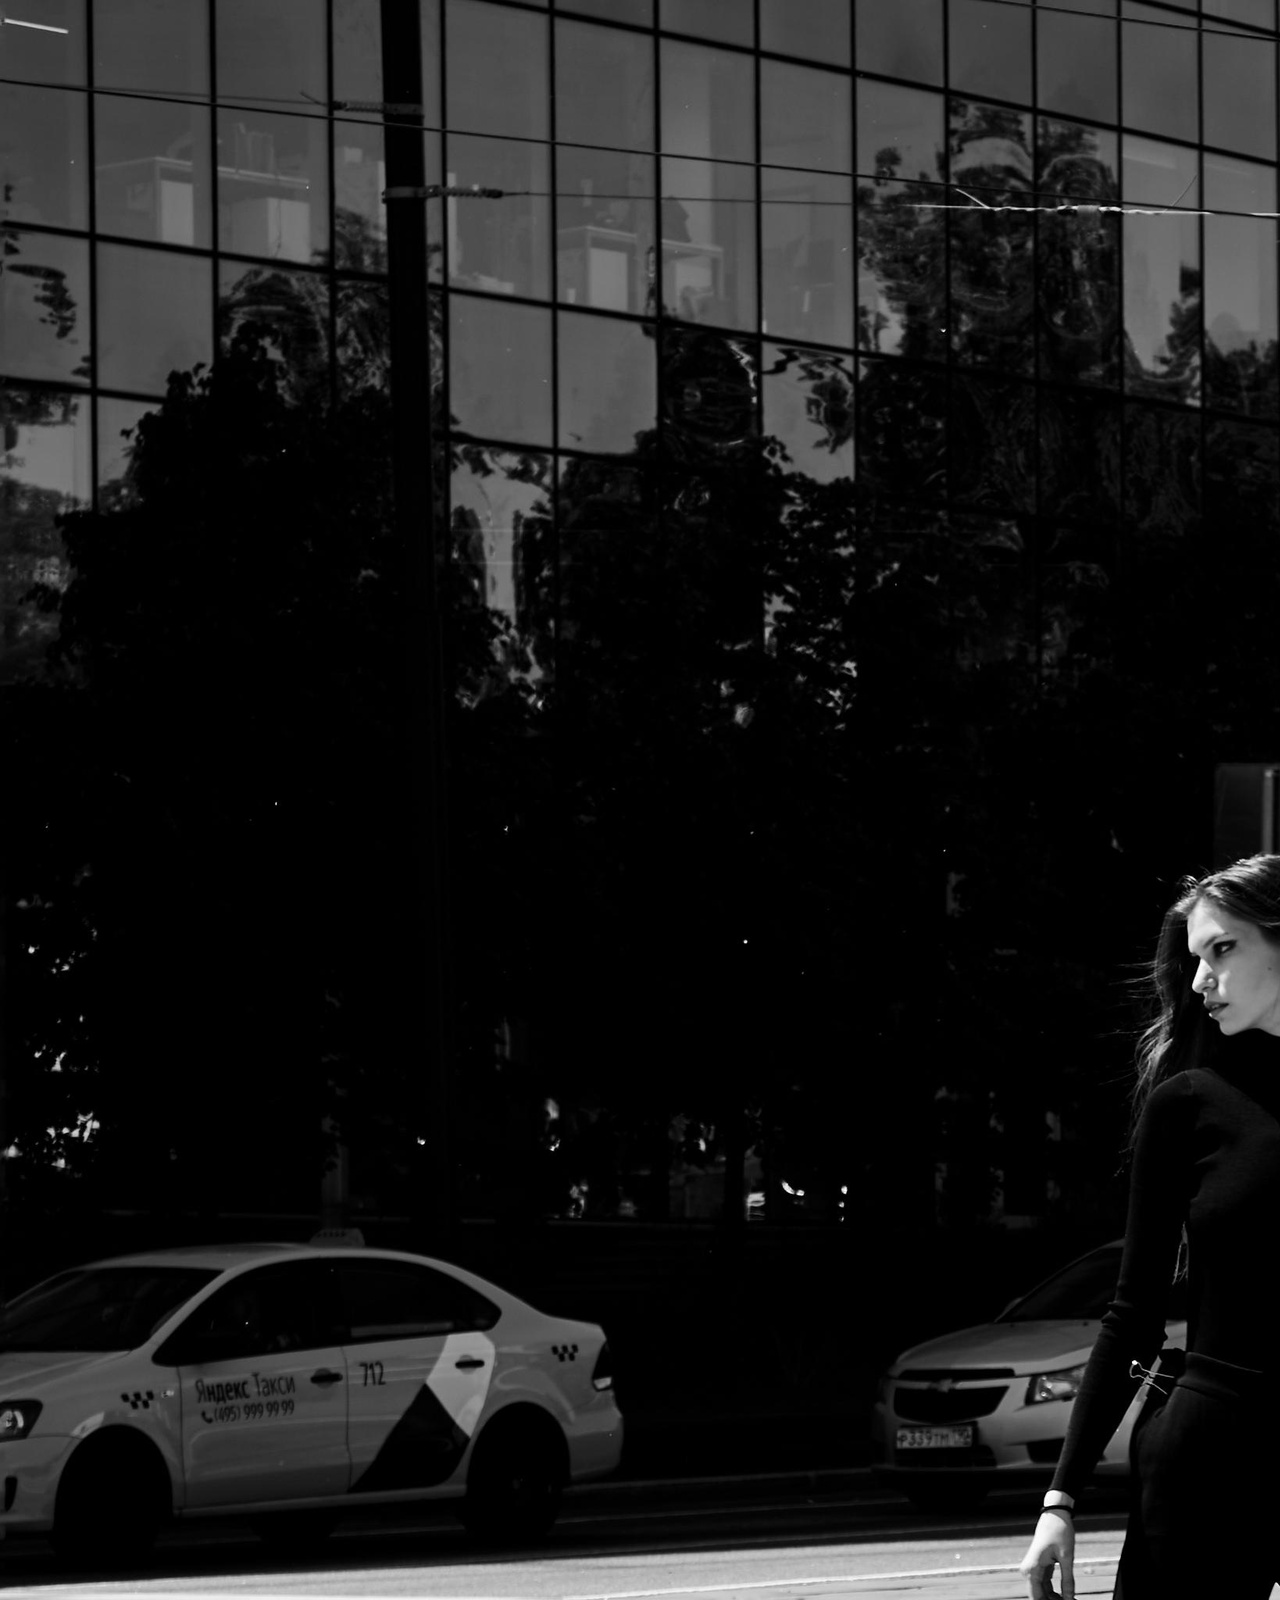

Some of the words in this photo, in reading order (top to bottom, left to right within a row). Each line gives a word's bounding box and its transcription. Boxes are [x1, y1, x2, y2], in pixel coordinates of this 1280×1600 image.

[359, 1360, 387, 1387] 712
[195, 1377, 250, 1405] Яндекс
[251, 1371, 296, 1397] Такси
[214, 1405, 241, 1423] (495)
[243, 1401, 264, 1420] 999
[266, 1400, 280, 1417] 99
[281, 1398, 296, 1416] 99
